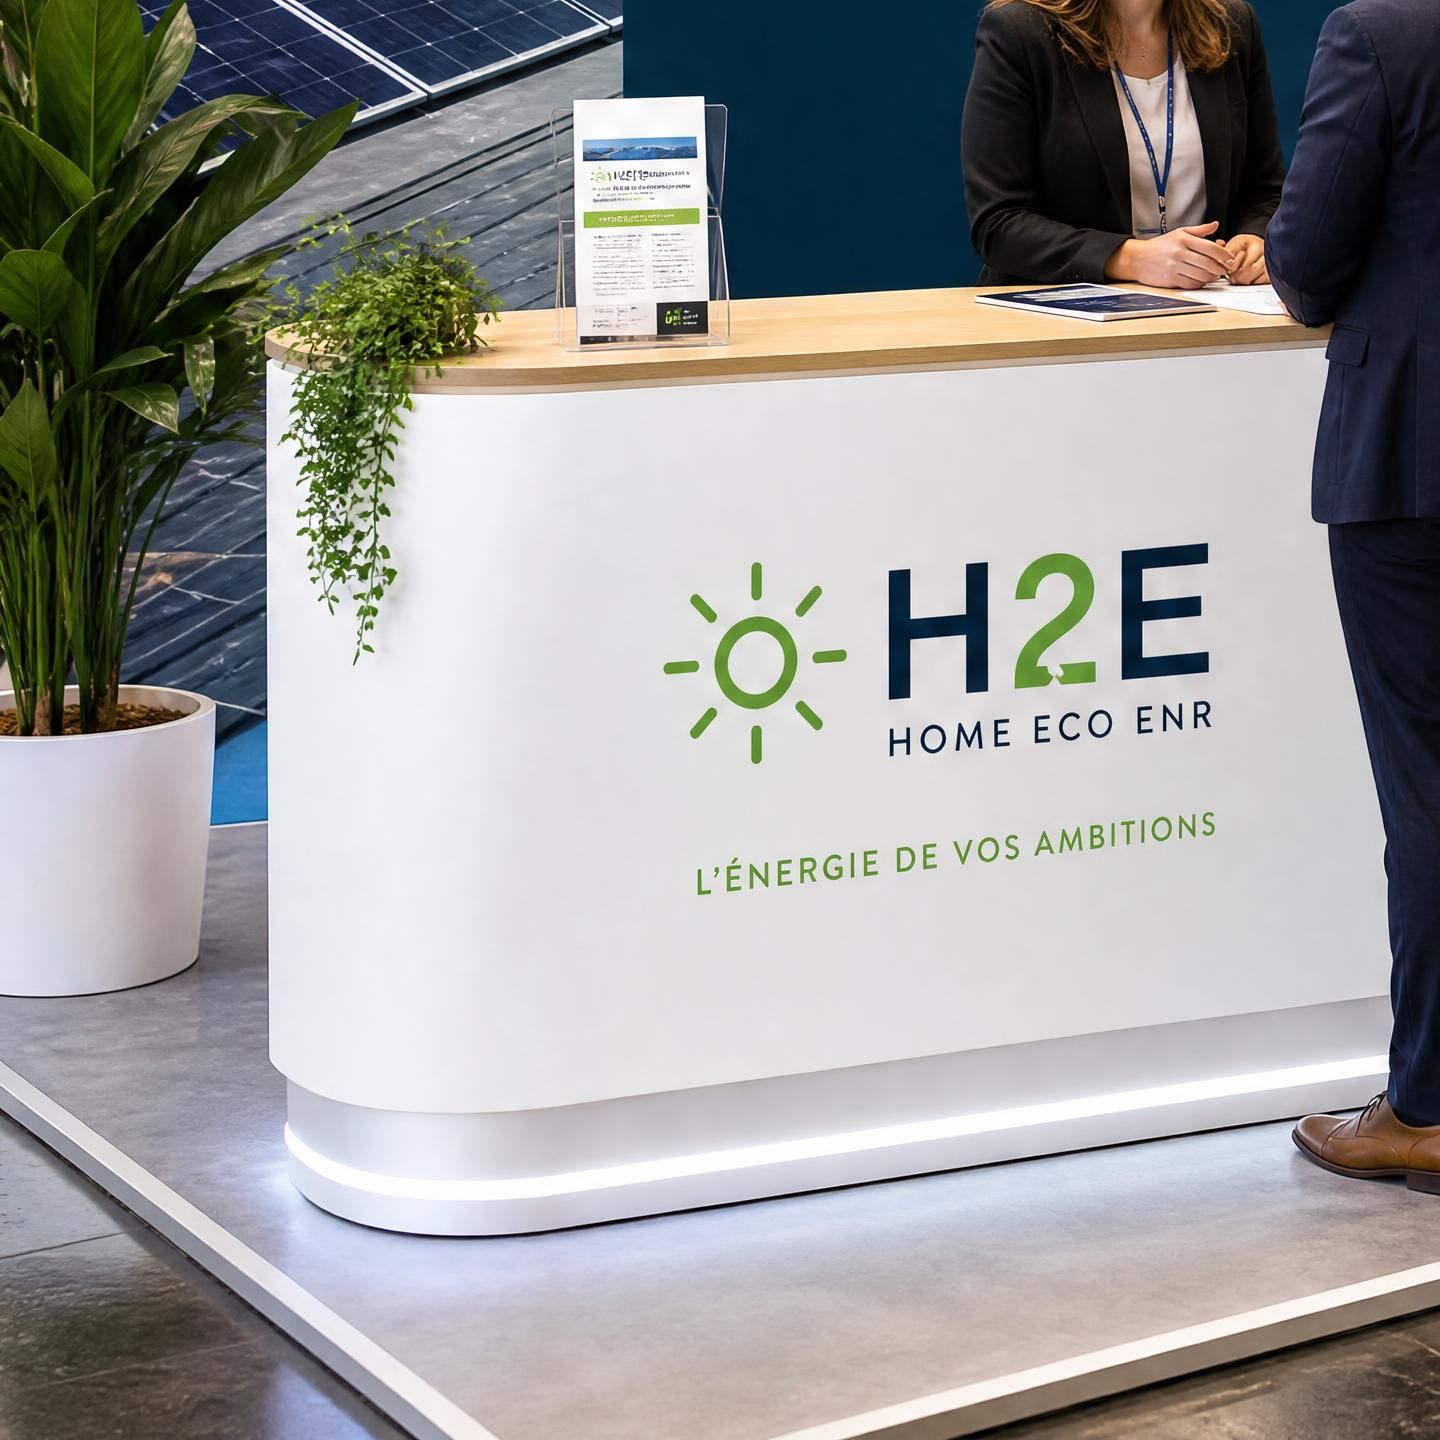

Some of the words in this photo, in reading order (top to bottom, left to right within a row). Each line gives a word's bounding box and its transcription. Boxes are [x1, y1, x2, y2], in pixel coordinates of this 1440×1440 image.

[889, 543, 1209, 700] H2E
[890, 719, 1010, 756] HOME
[1035, 710, 1112, 743] ECO
[1137, 701, 1211, 734] ENR
[698, 850, 878, 895] L’ÉNERGIE
[897, 844, 937, 872] DE
[953, 835, 1019, 864] VOS
[1035, 812, 1215, 856] AMBITIONS
